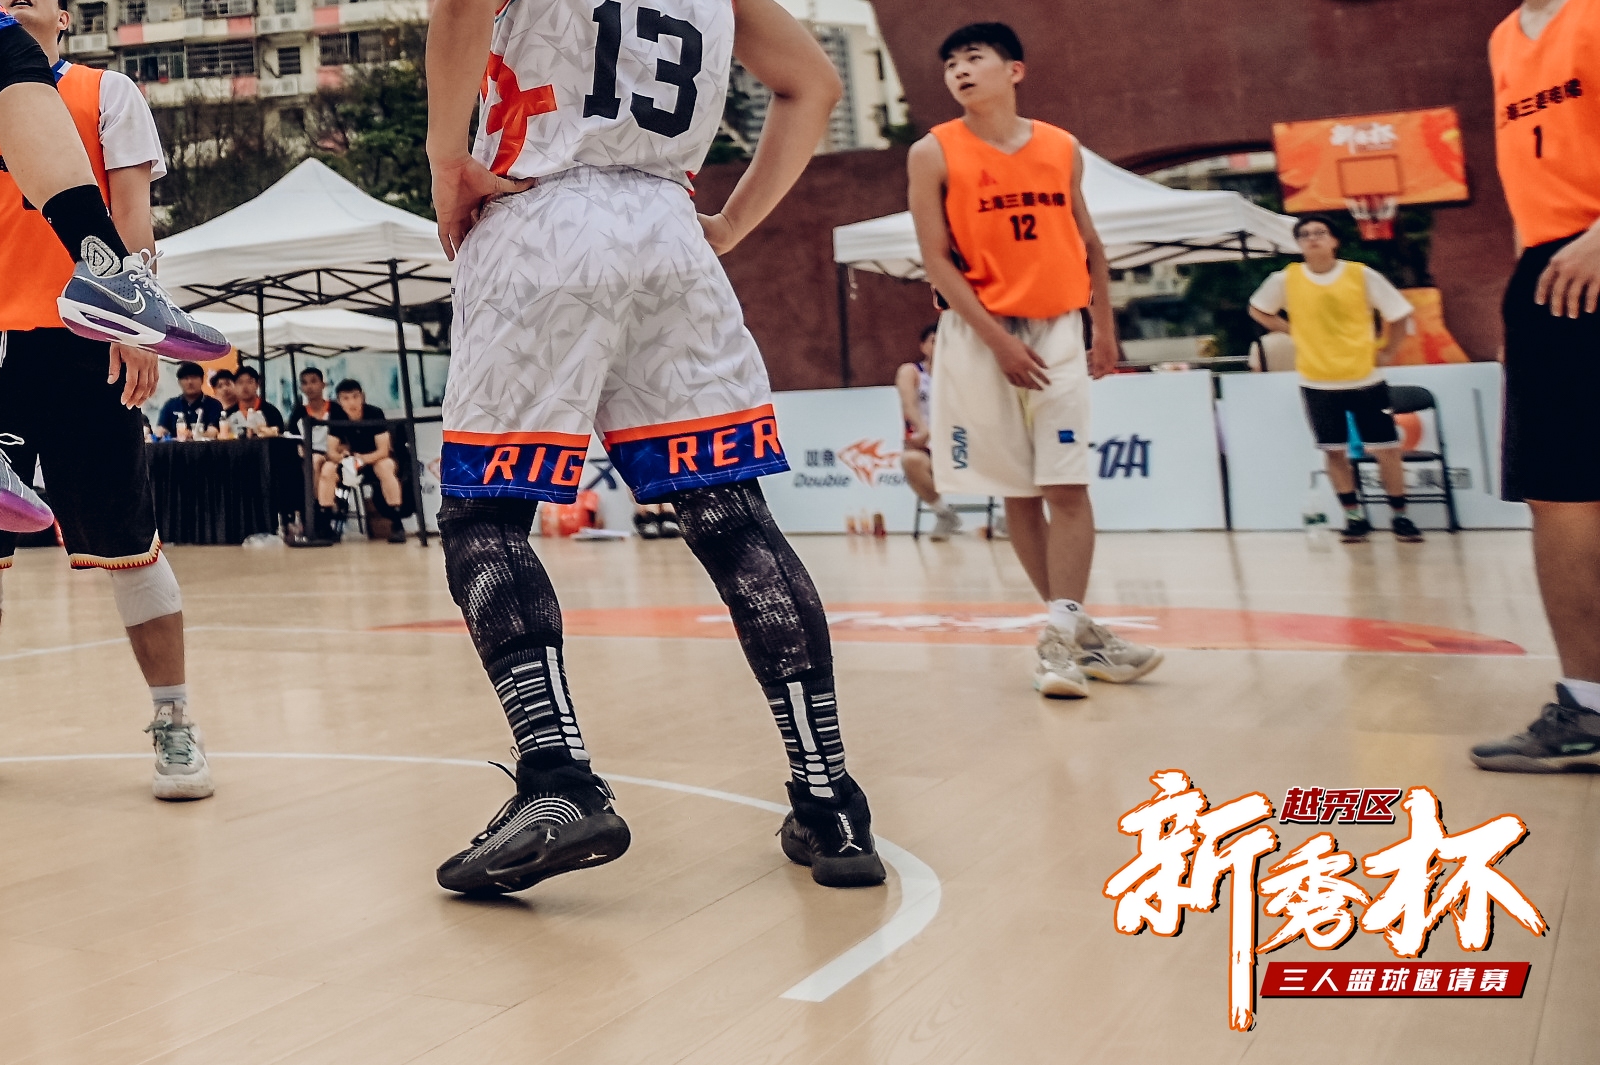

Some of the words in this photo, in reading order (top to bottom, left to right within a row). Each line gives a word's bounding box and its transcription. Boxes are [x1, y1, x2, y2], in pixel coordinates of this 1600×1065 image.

[582, 0, 703, 138] 13
[1533, 125, 1542, 159] 1
[1009, 214, 1038, 241] 12
[1088, 434, 1151, 479] 体
